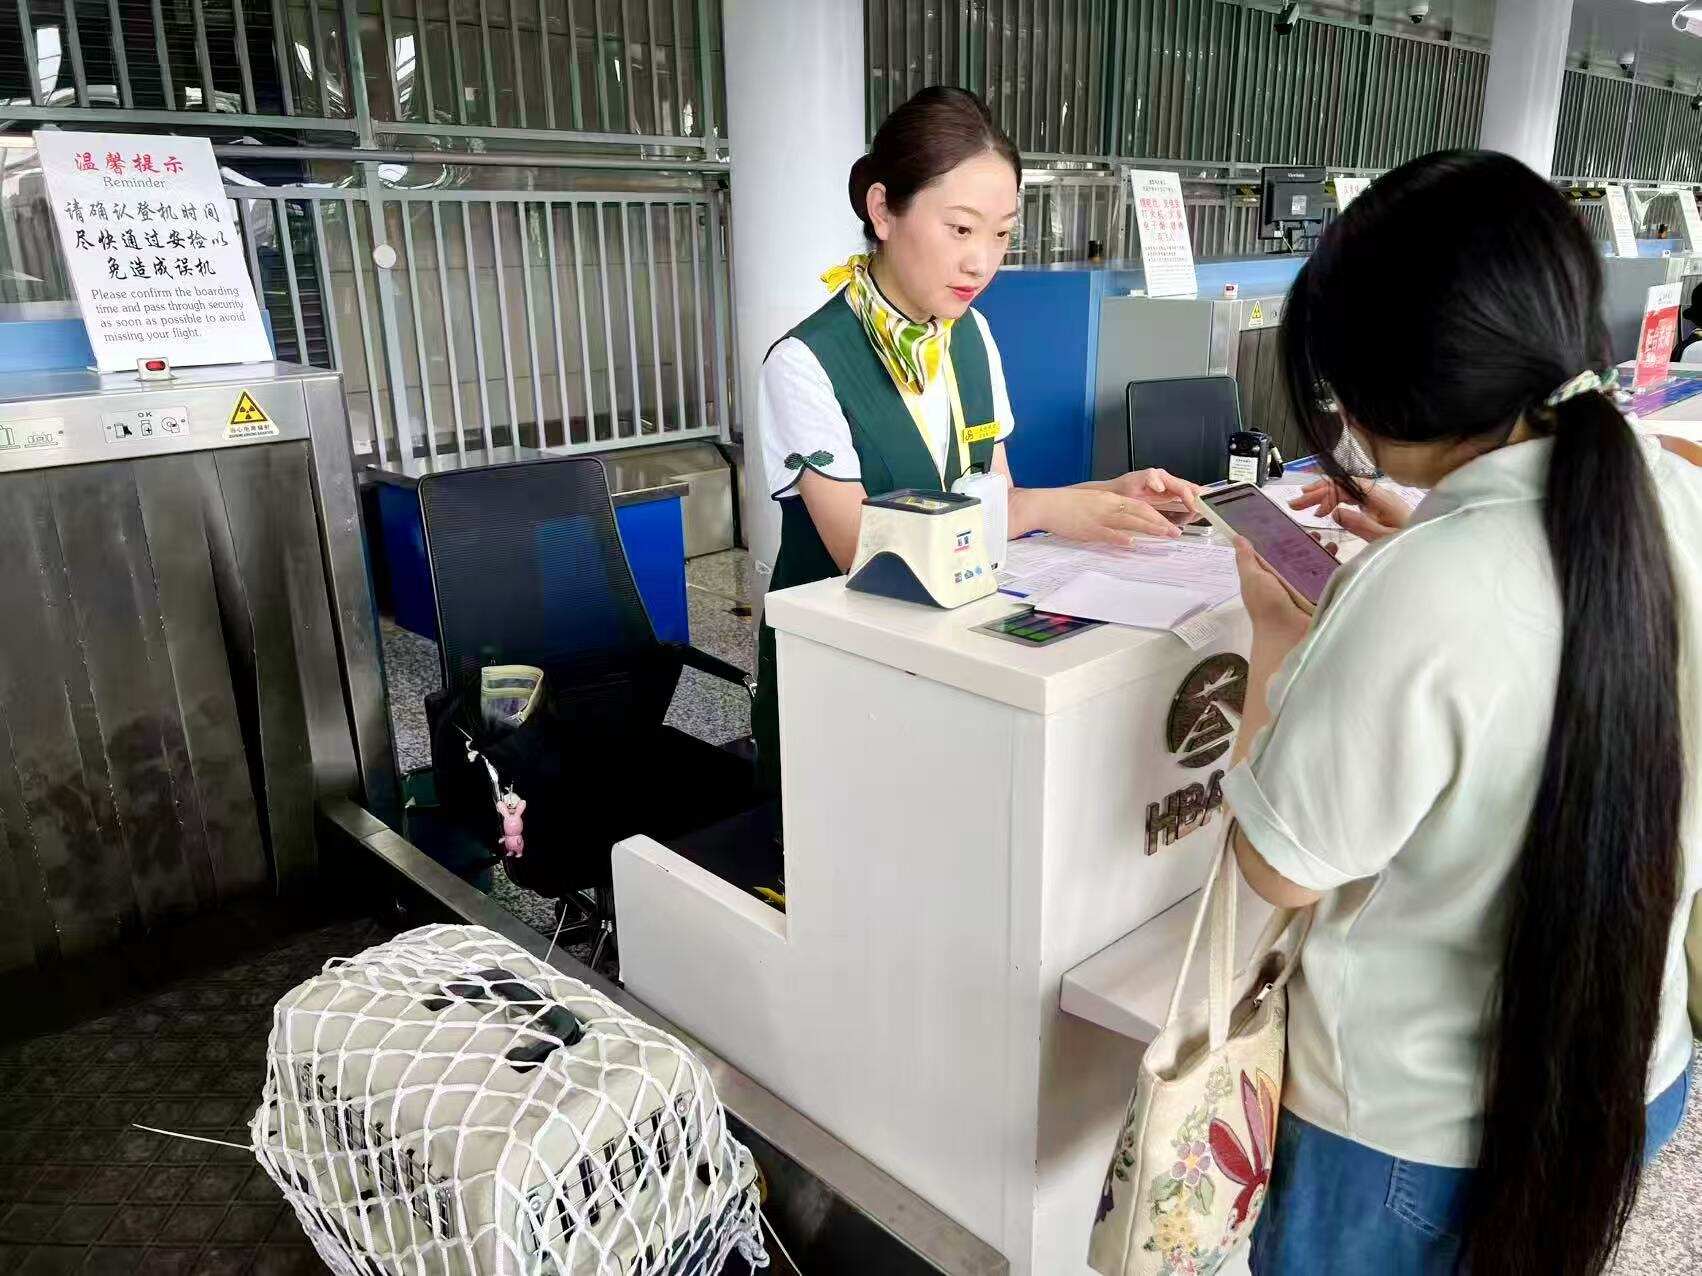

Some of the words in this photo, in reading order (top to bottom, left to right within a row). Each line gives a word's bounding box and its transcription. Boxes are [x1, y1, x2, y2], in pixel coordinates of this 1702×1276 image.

[74, 152, 184, 175] 温馨提示
[103, 176, 166, 188] Reminder
[64, 199, 220, 223] 请确认登机时间
[75, 229, 228, 250] 尽快通过安检以
[107, 256, 216, 280] 免造成误机
[91, 288, 127, 299] Please
[131, 287, 172, 298] confirm
[175, 286, 192, 297] the
[195, 286, 240, 298] boarding
[96, 304, 118, 314] time
[122, 302, 141, 313] and
[144, 304, 165, 314] pass
[168, 300, 205, 312] through
[208, 300, 244, 311] security
[100, 319, 112, 328] as
[116, 318, 142, 327] soon
[146, 317, 157, 326] as
[161, 313, 202, 327] possible
[205, 314, 216, 323] to
[219, 312, 246, 323] avoid
[104, 331, 144, 343] missing
[147, 331, 170, 342] your
[173, 328, 202, 340] flight.
